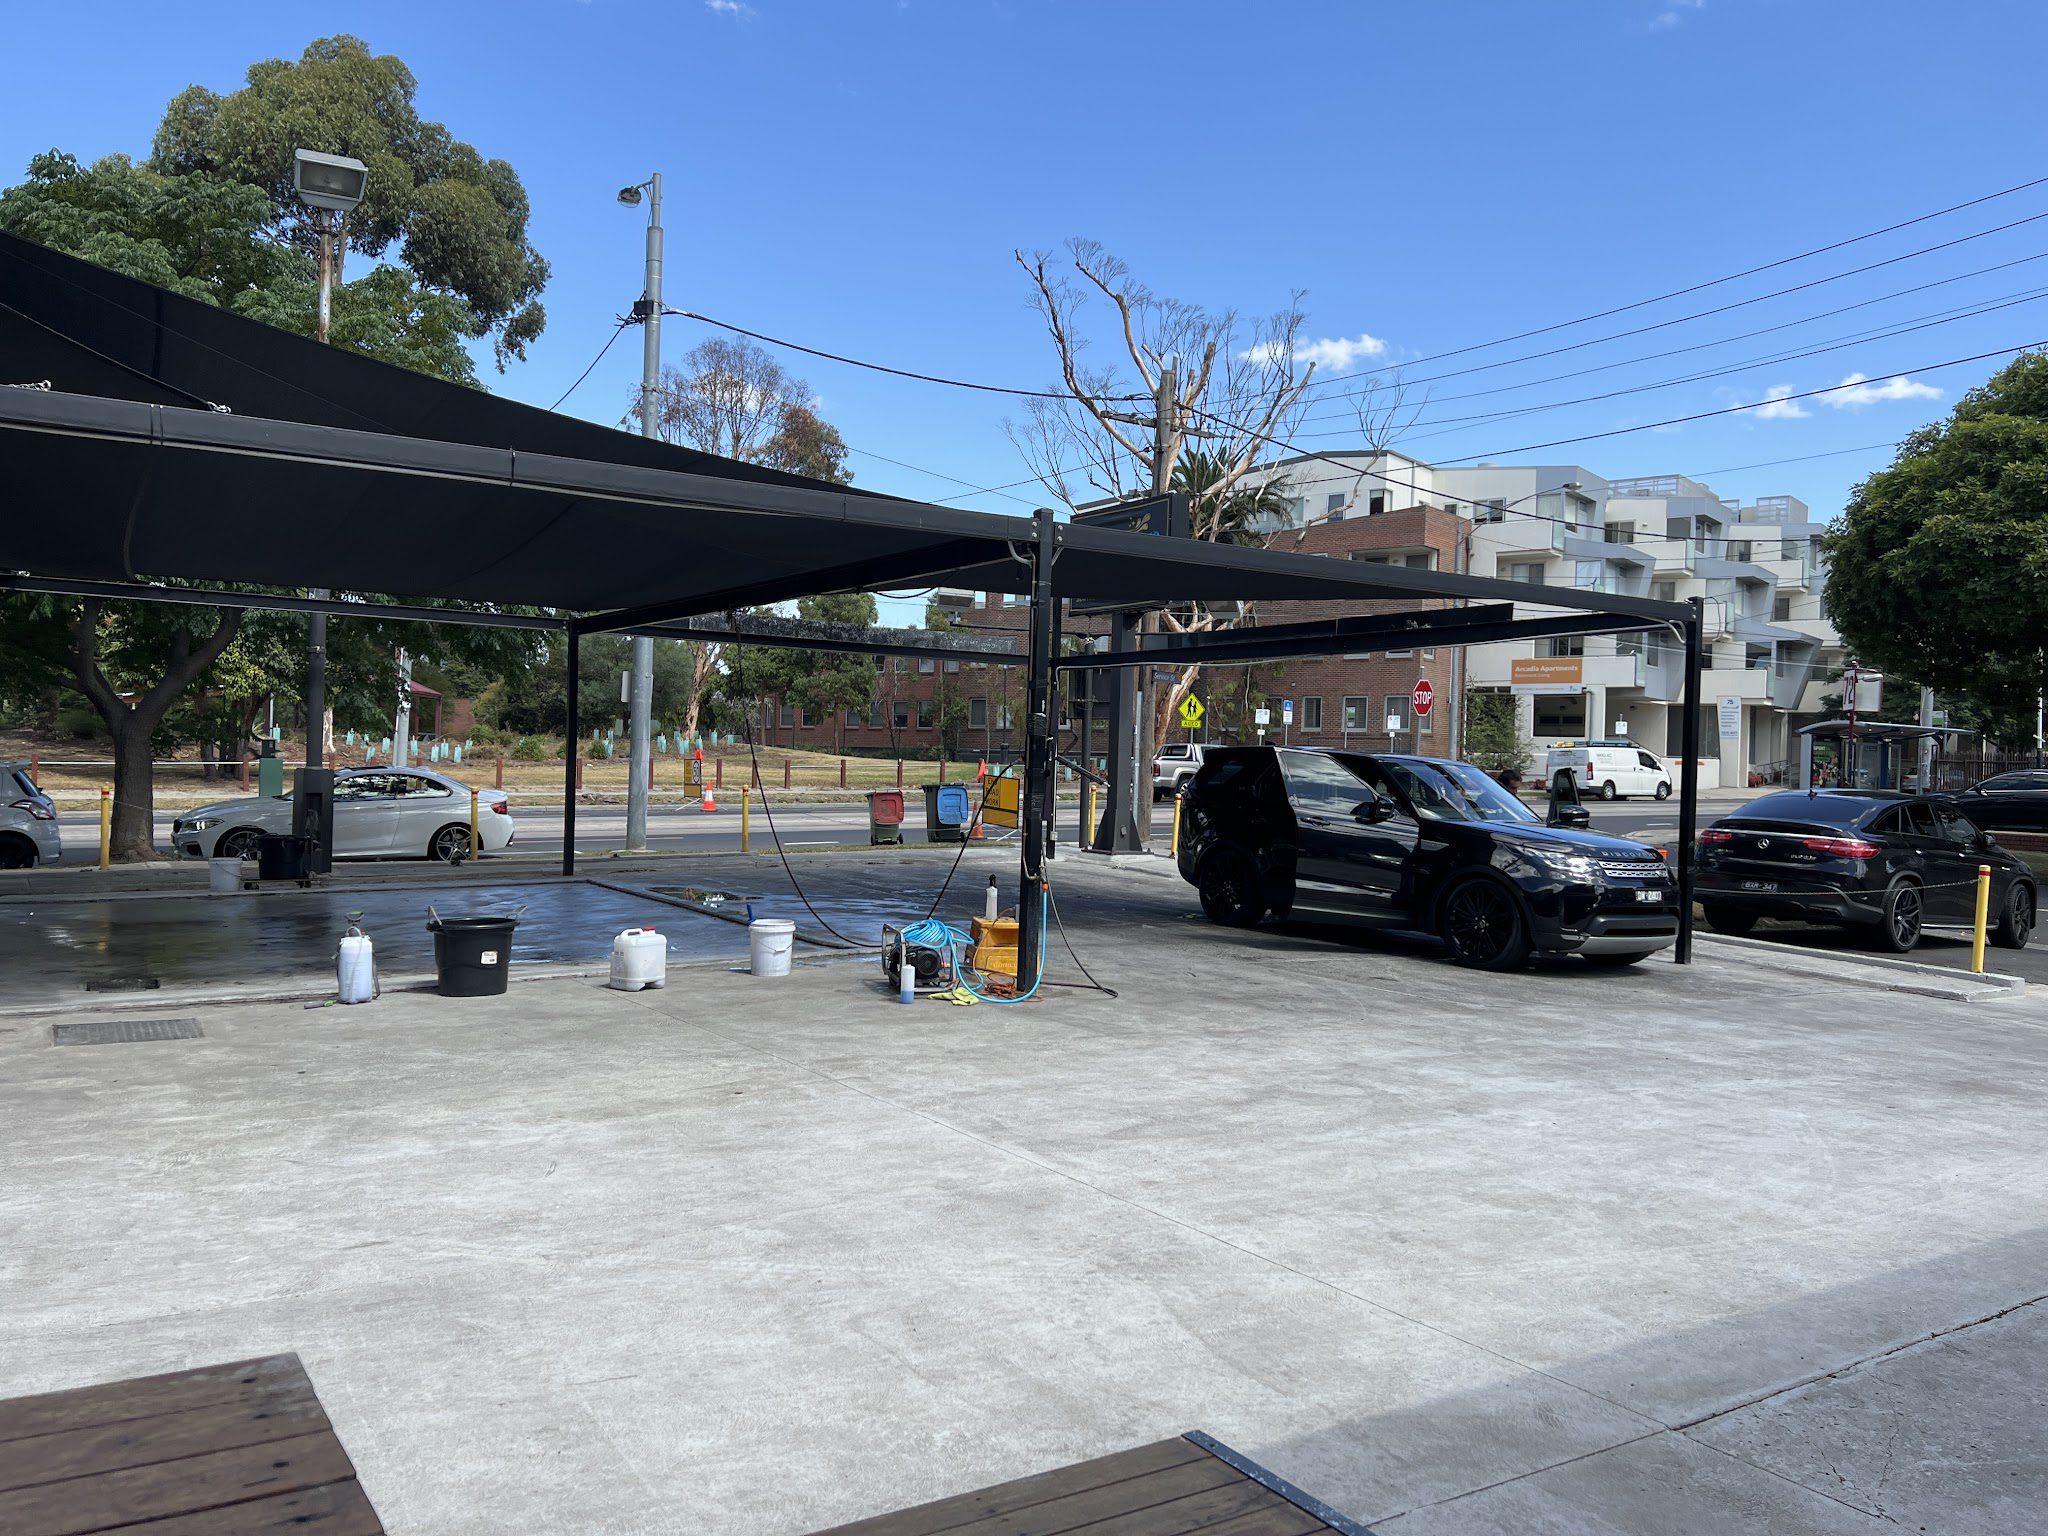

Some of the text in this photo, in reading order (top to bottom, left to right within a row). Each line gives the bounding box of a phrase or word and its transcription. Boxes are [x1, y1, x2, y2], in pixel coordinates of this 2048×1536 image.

[1540, 664, 1578, 672] Apartments
[1153, 672, 1170, 681] Service
[1414, 691, 1432, 704] STOP
